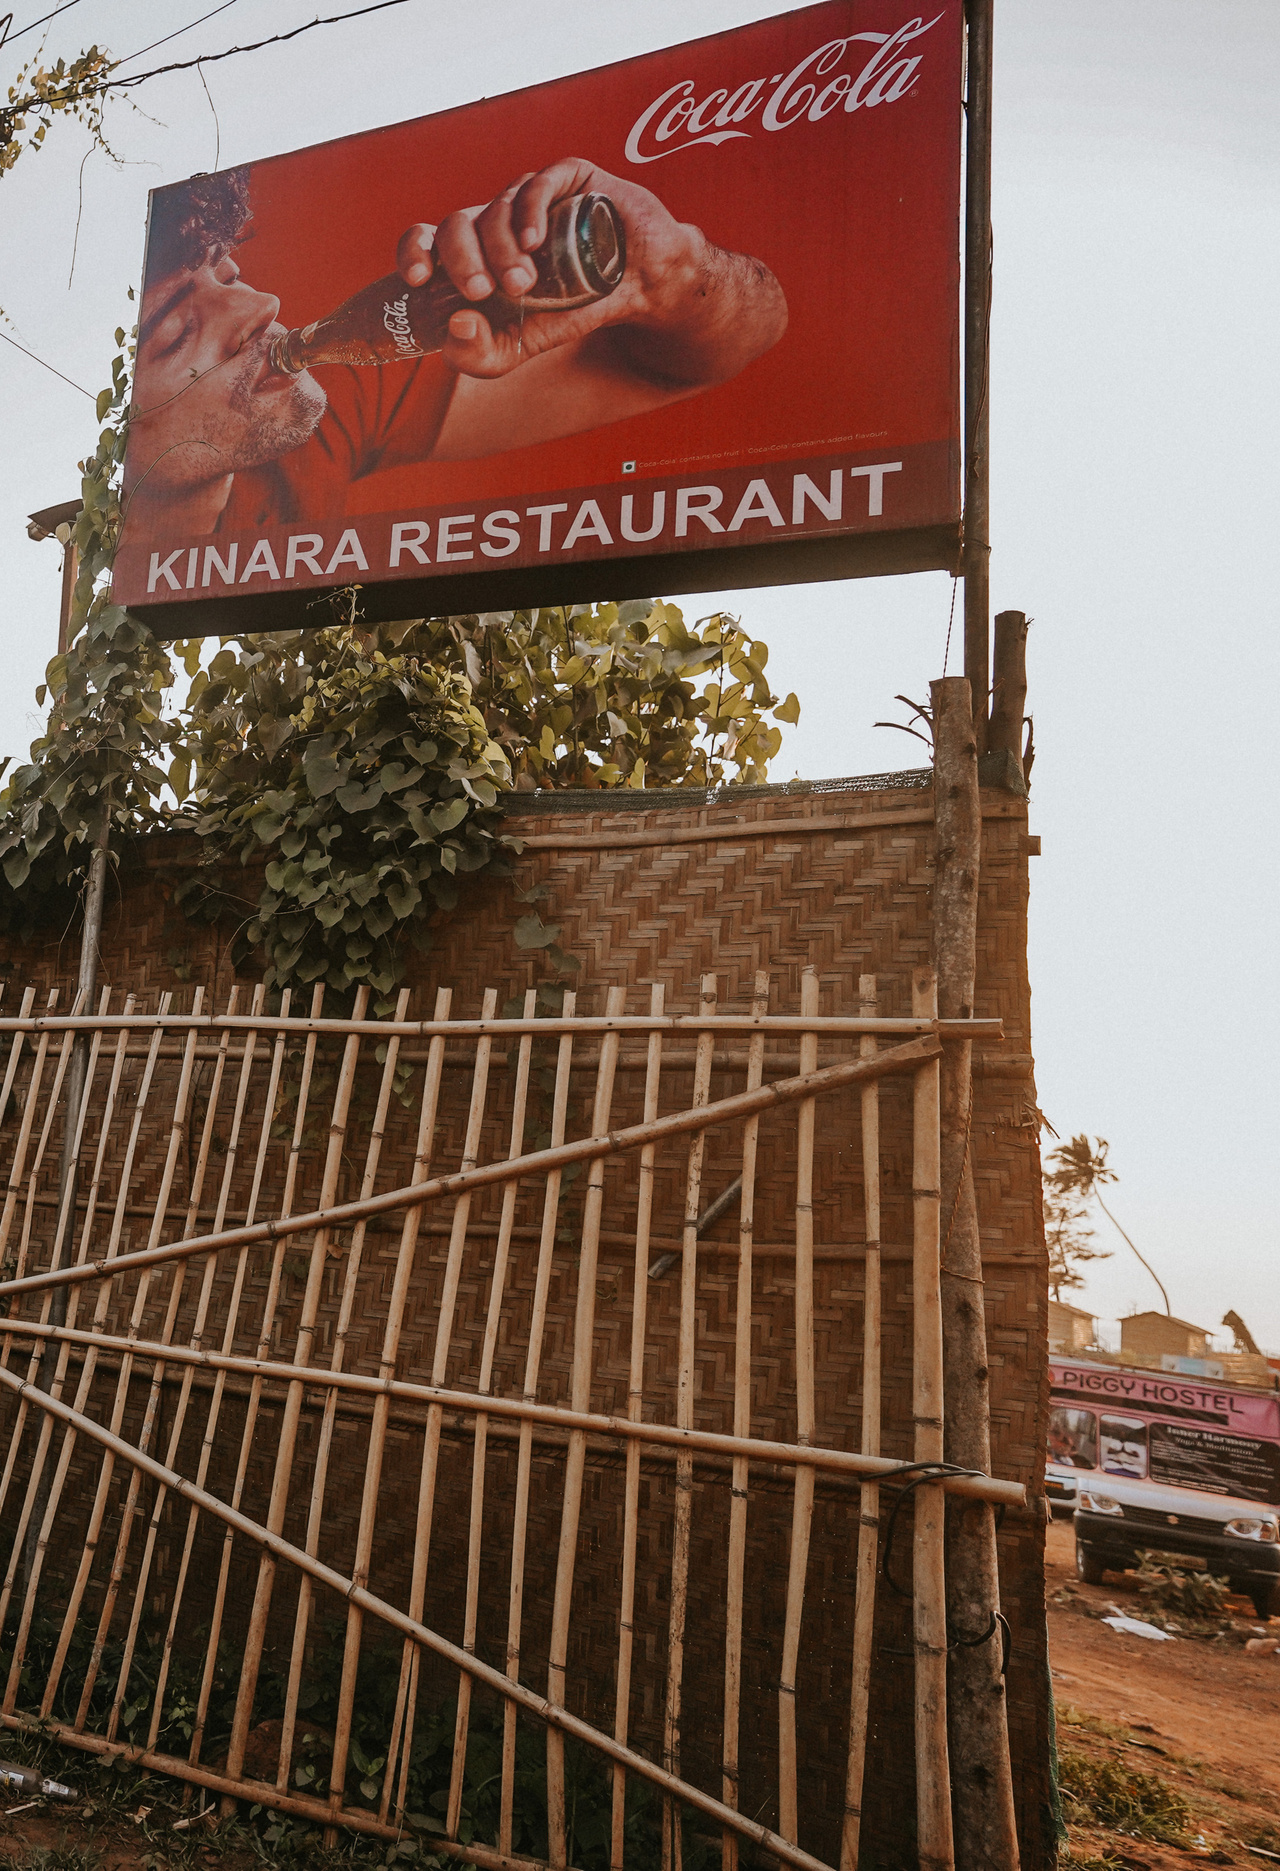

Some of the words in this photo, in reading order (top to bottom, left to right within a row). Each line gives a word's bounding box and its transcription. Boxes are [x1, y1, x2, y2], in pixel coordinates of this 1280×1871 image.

[625, 10, 946, 164] Coca-Cola
[383, 300, 423, 355] Coca-Cola
[679, 453, 710, 463] contains
[792, 438, 825, 448] contains
[827, 435, 853, 444] added
[855, 430, 888, 440] flavours
[147, 528, 369, 593] KINARA
[389, 461, 902, 568] RESTAURANT
[1063, 1371, 1136, 1395] PIGGY
[1142, 1383, 1244, 1414] HOSTEL
